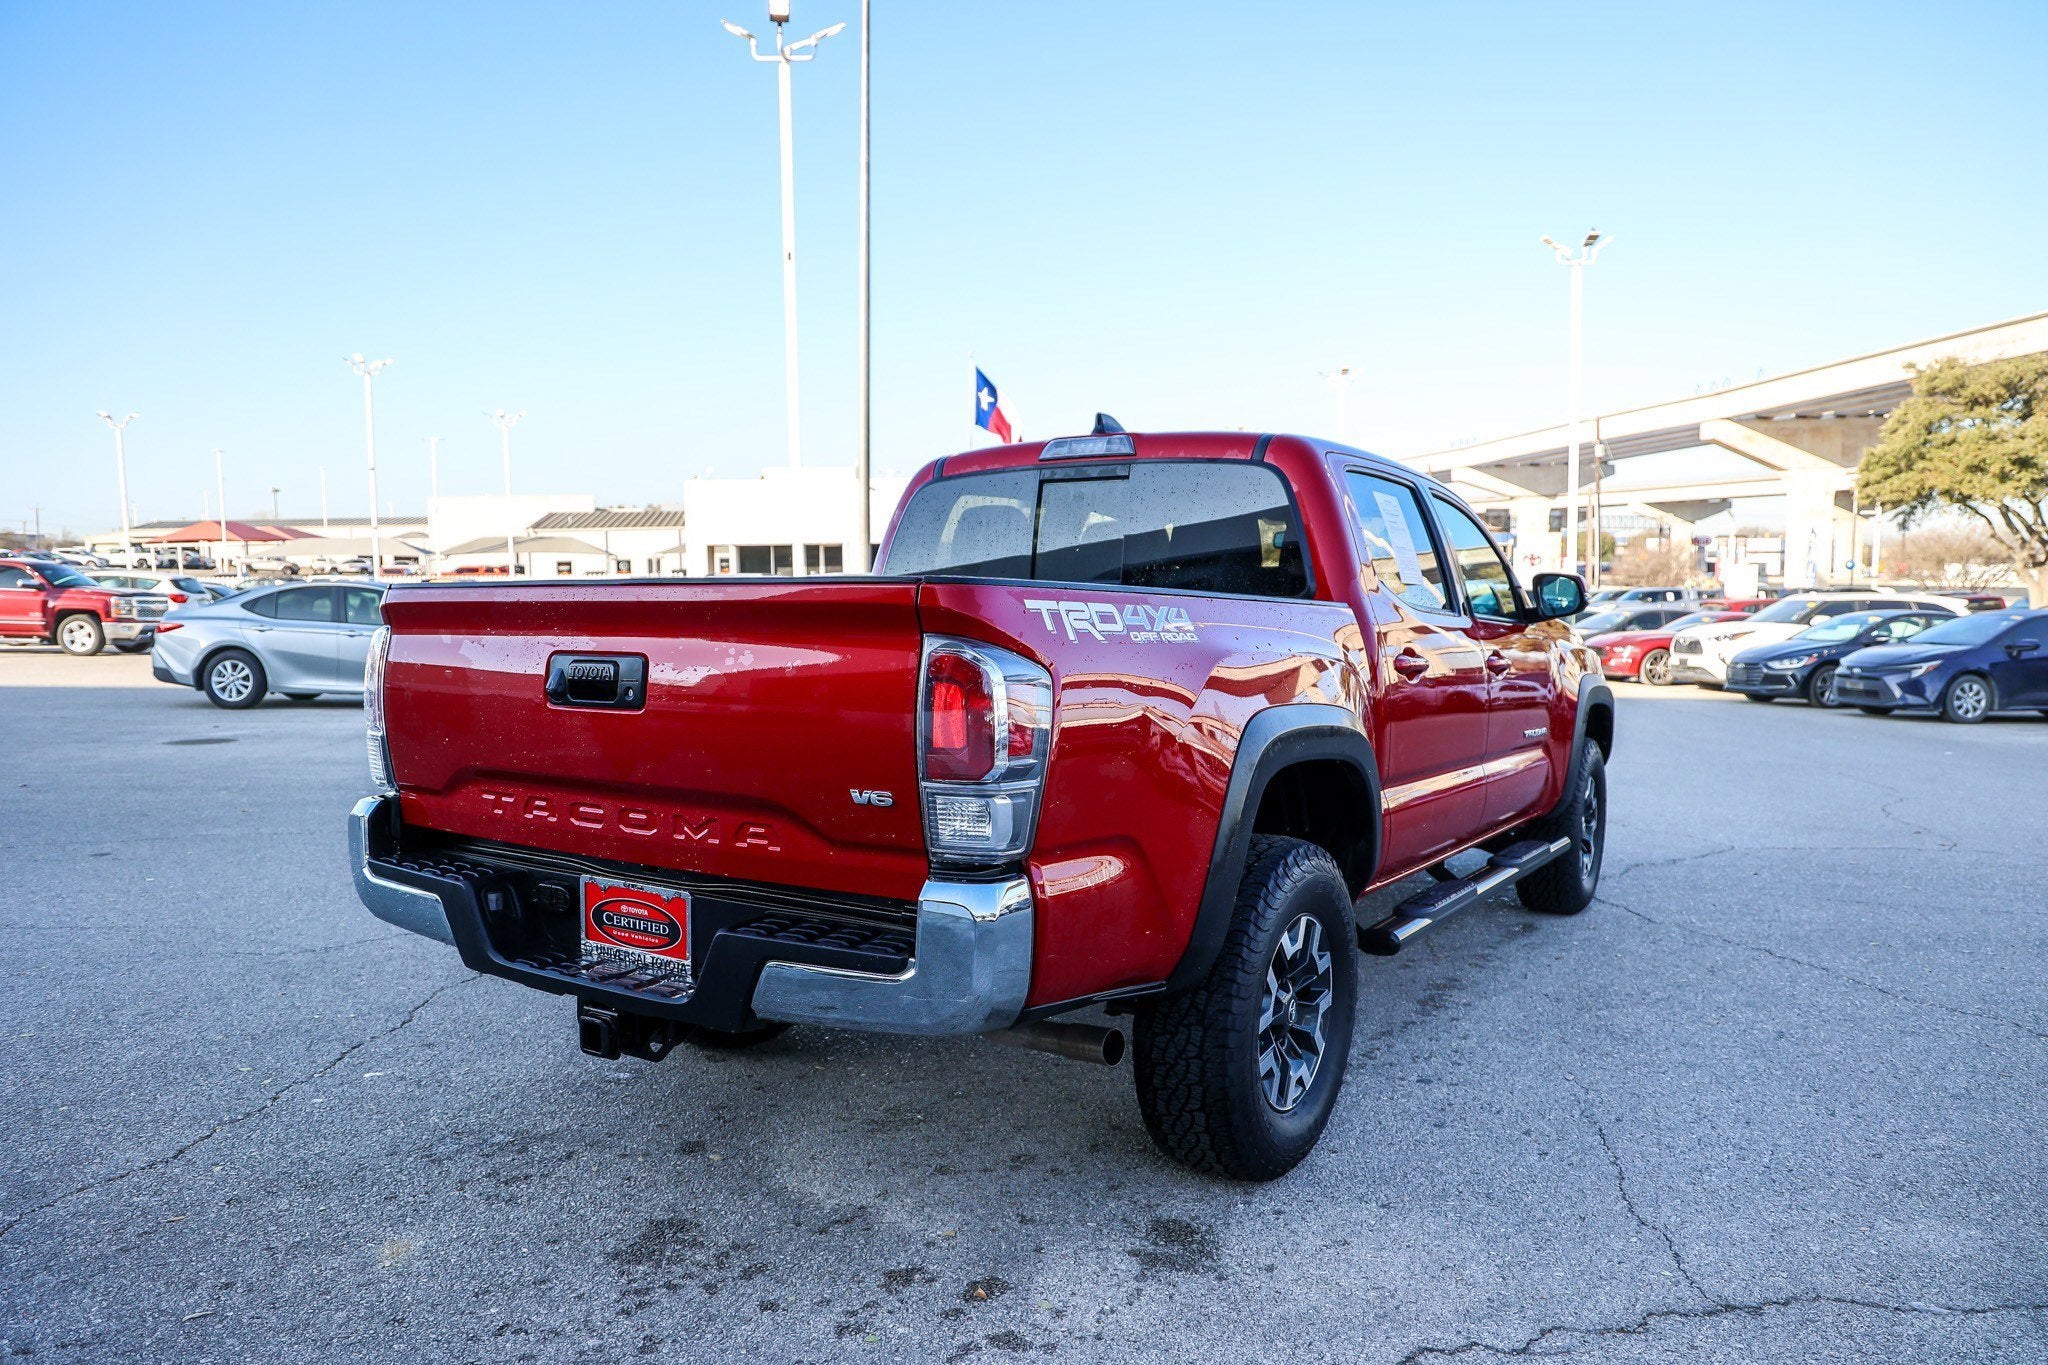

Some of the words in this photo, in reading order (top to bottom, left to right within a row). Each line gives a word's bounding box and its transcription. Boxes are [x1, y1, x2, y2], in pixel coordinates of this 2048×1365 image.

[1023, 598, 1128, 644] TRD
[1129, 631, 1159, 643] OFF
[1160, 631, 1199, 643] ROAD
[570, 665, 611, 678] TOYOTA
[849, 788, 894, 807] V6
[480, 791, 782, 852] TACOMA
[628, 906, 649, 916] TOYOTA
[602, 912, 669, 935] CERTIFIED
[612, 929, 630, 938] Used
[630, 933, 659, 944] Vehicles
[595, 944, 649, 964] UNIVERSAL
[651, 956, 688, 974] TOYOTA
